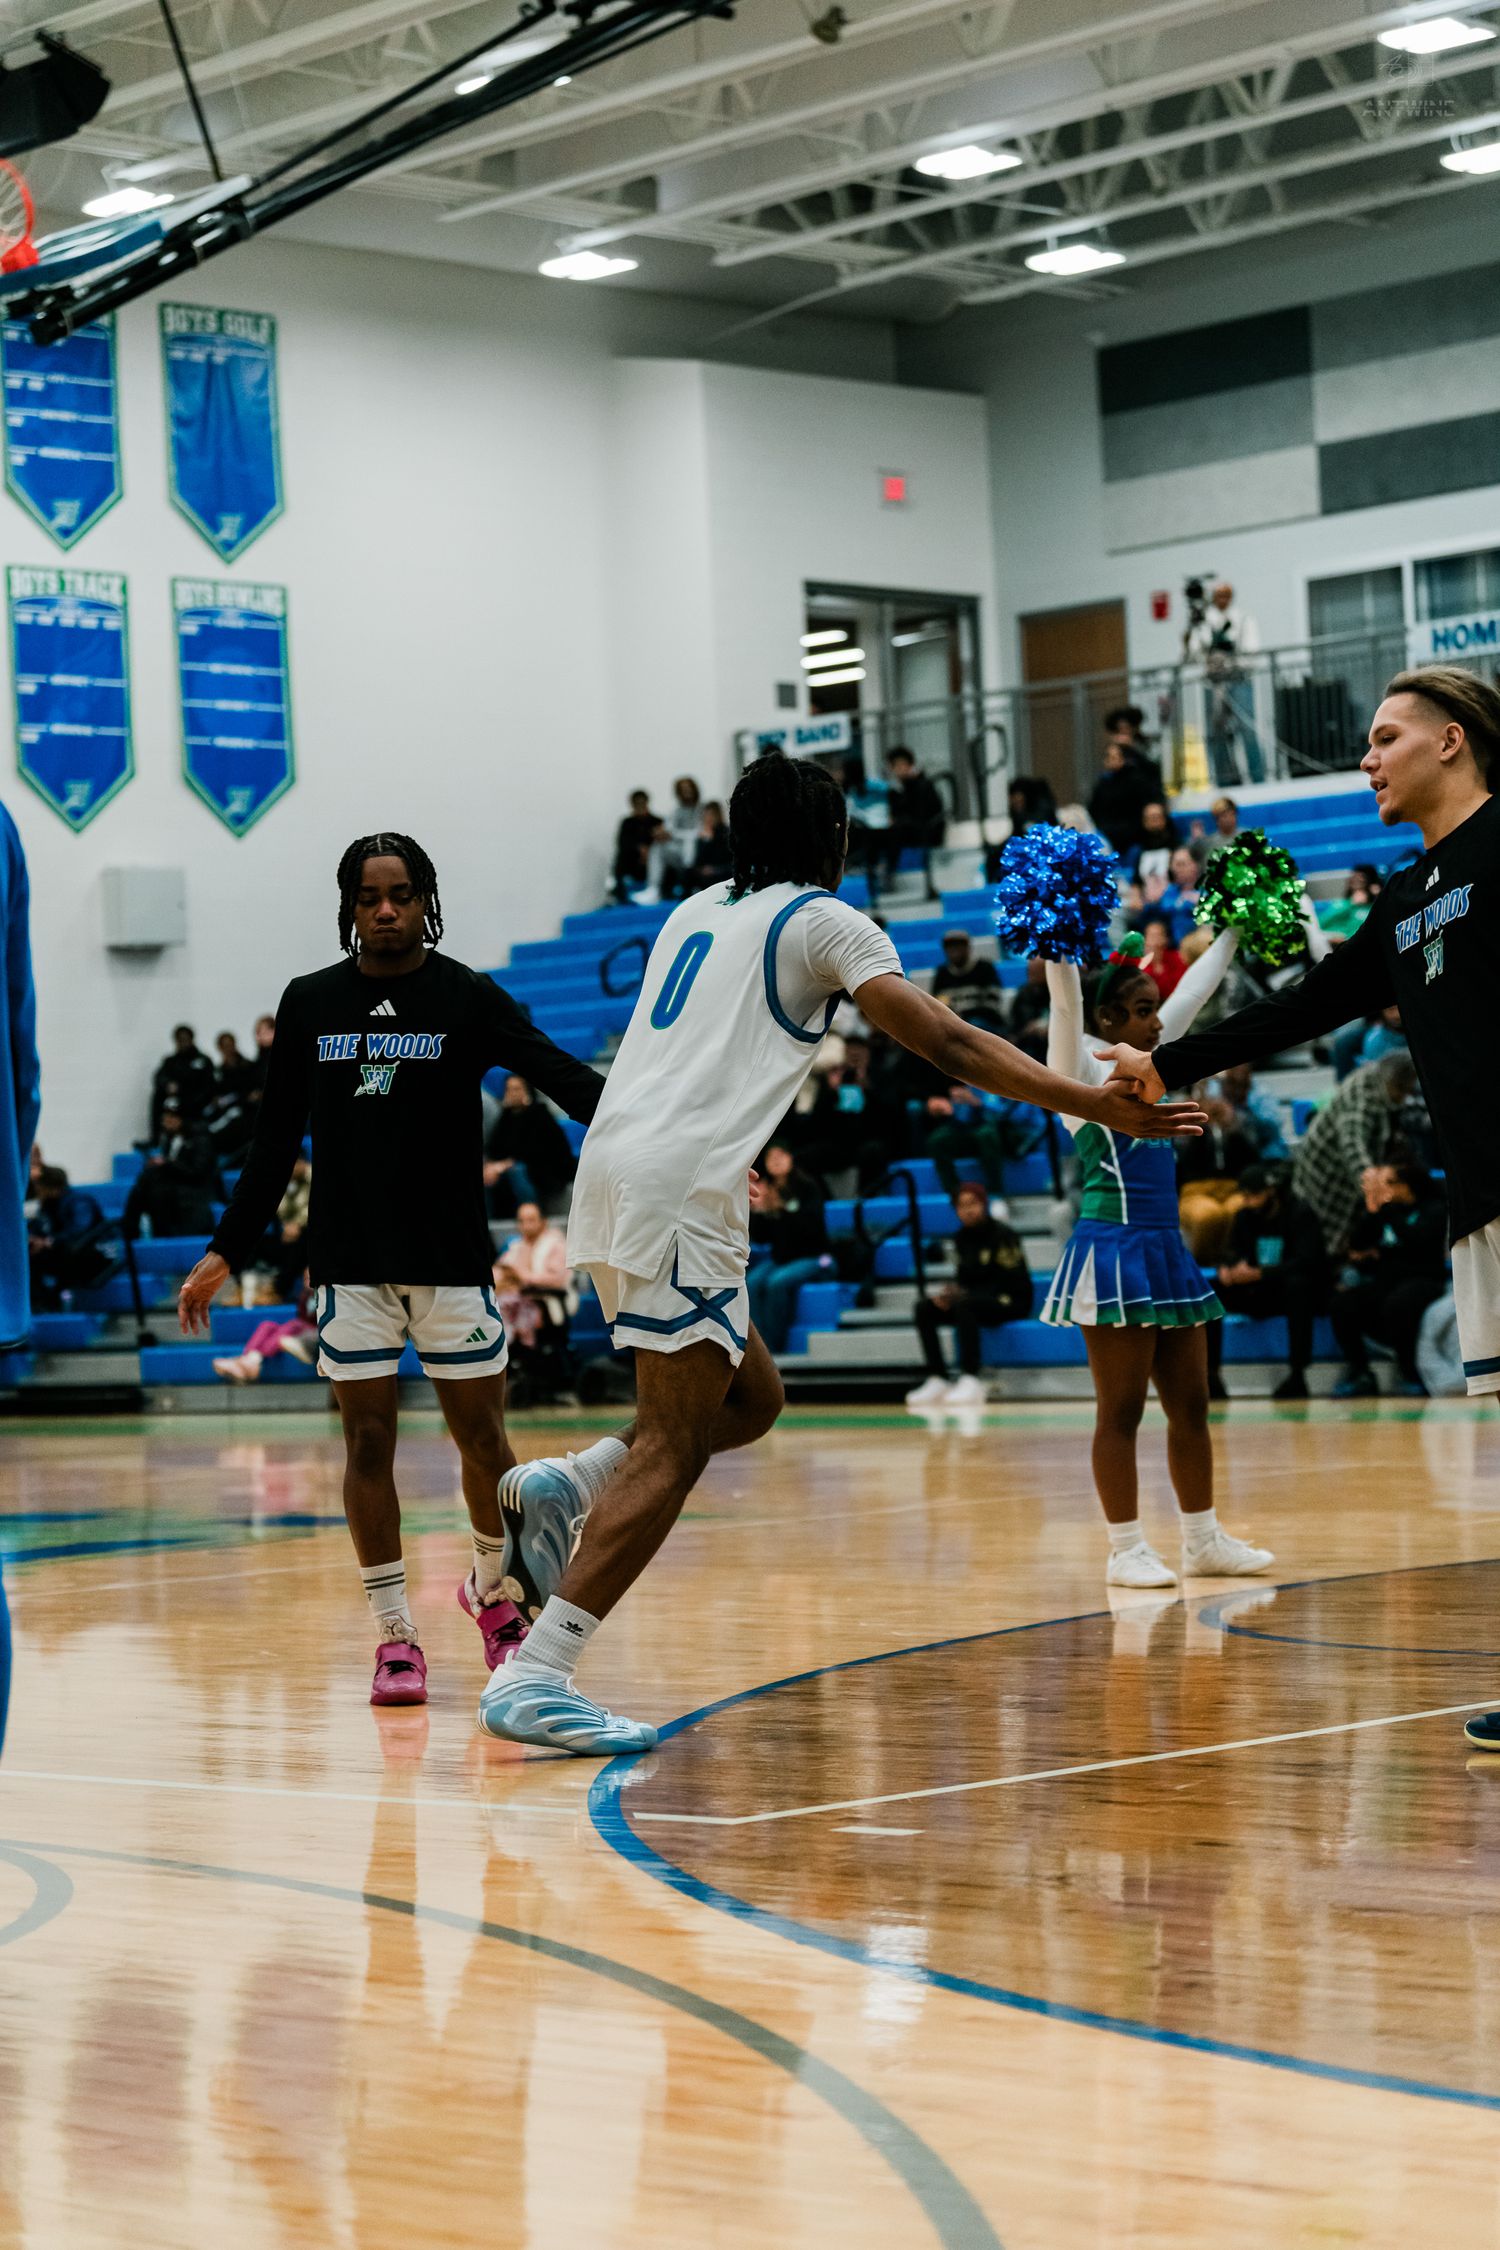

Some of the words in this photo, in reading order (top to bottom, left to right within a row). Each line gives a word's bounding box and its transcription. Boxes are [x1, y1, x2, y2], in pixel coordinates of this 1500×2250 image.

[1395, 911, 1422, 954] THE
[1424, 883, 1475, 939] WOODS
[650, 930, 715, 1031] 0
[317, 1033, 361, 1062] THE
[366, 1033, 447, 1061] WOODS
